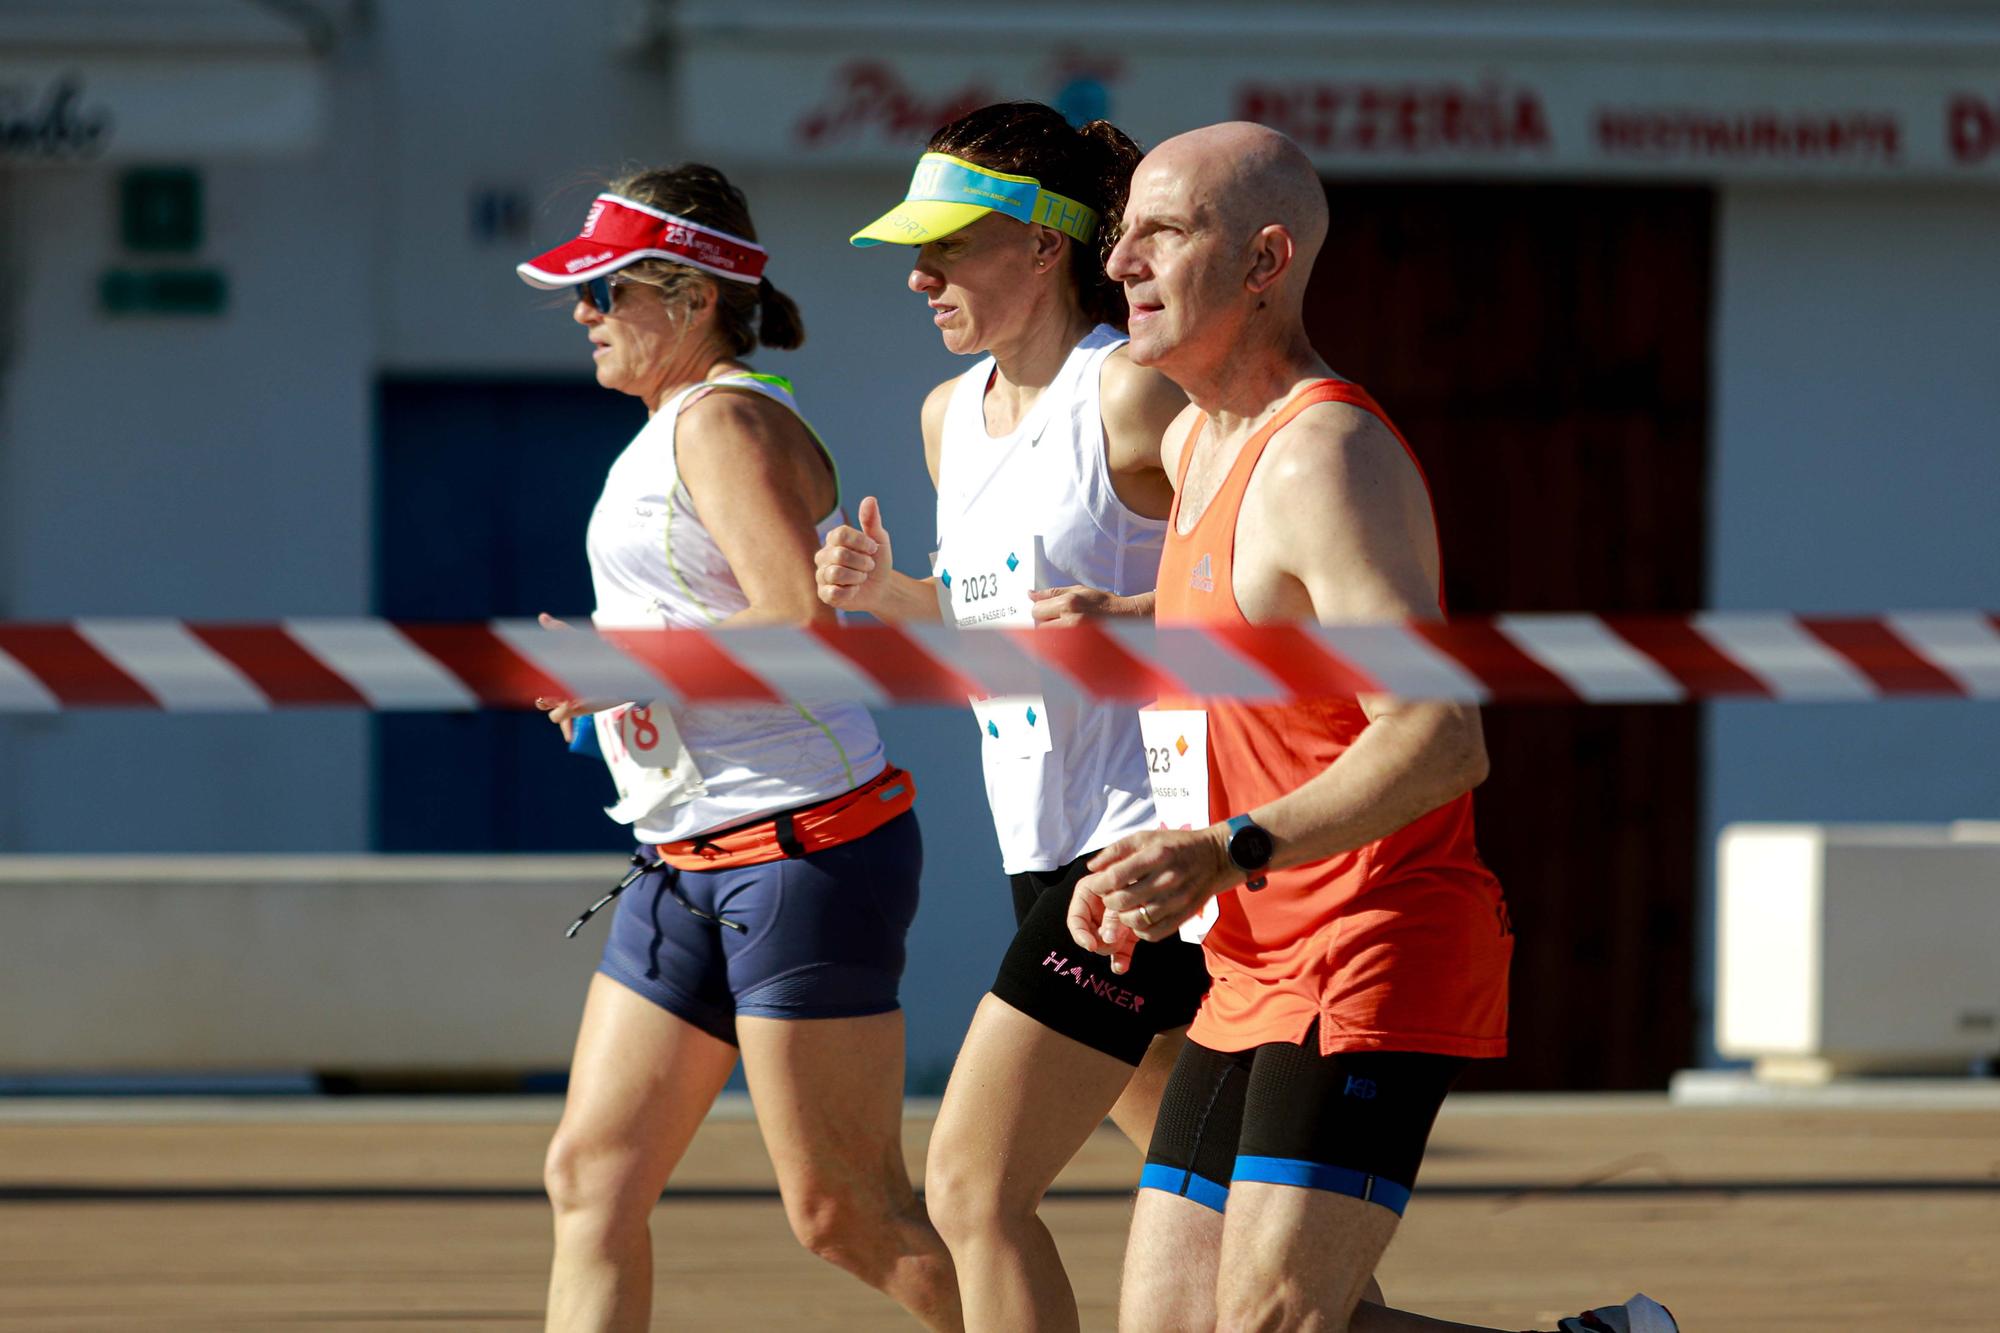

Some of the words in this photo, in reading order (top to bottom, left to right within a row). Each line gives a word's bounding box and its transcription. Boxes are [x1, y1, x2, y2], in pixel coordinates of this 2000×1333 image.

[962, 573, 998, 602] 2023
[1147, 747, 1171, 773] 23
[1042, 951, 1144, 1012] HANKER
